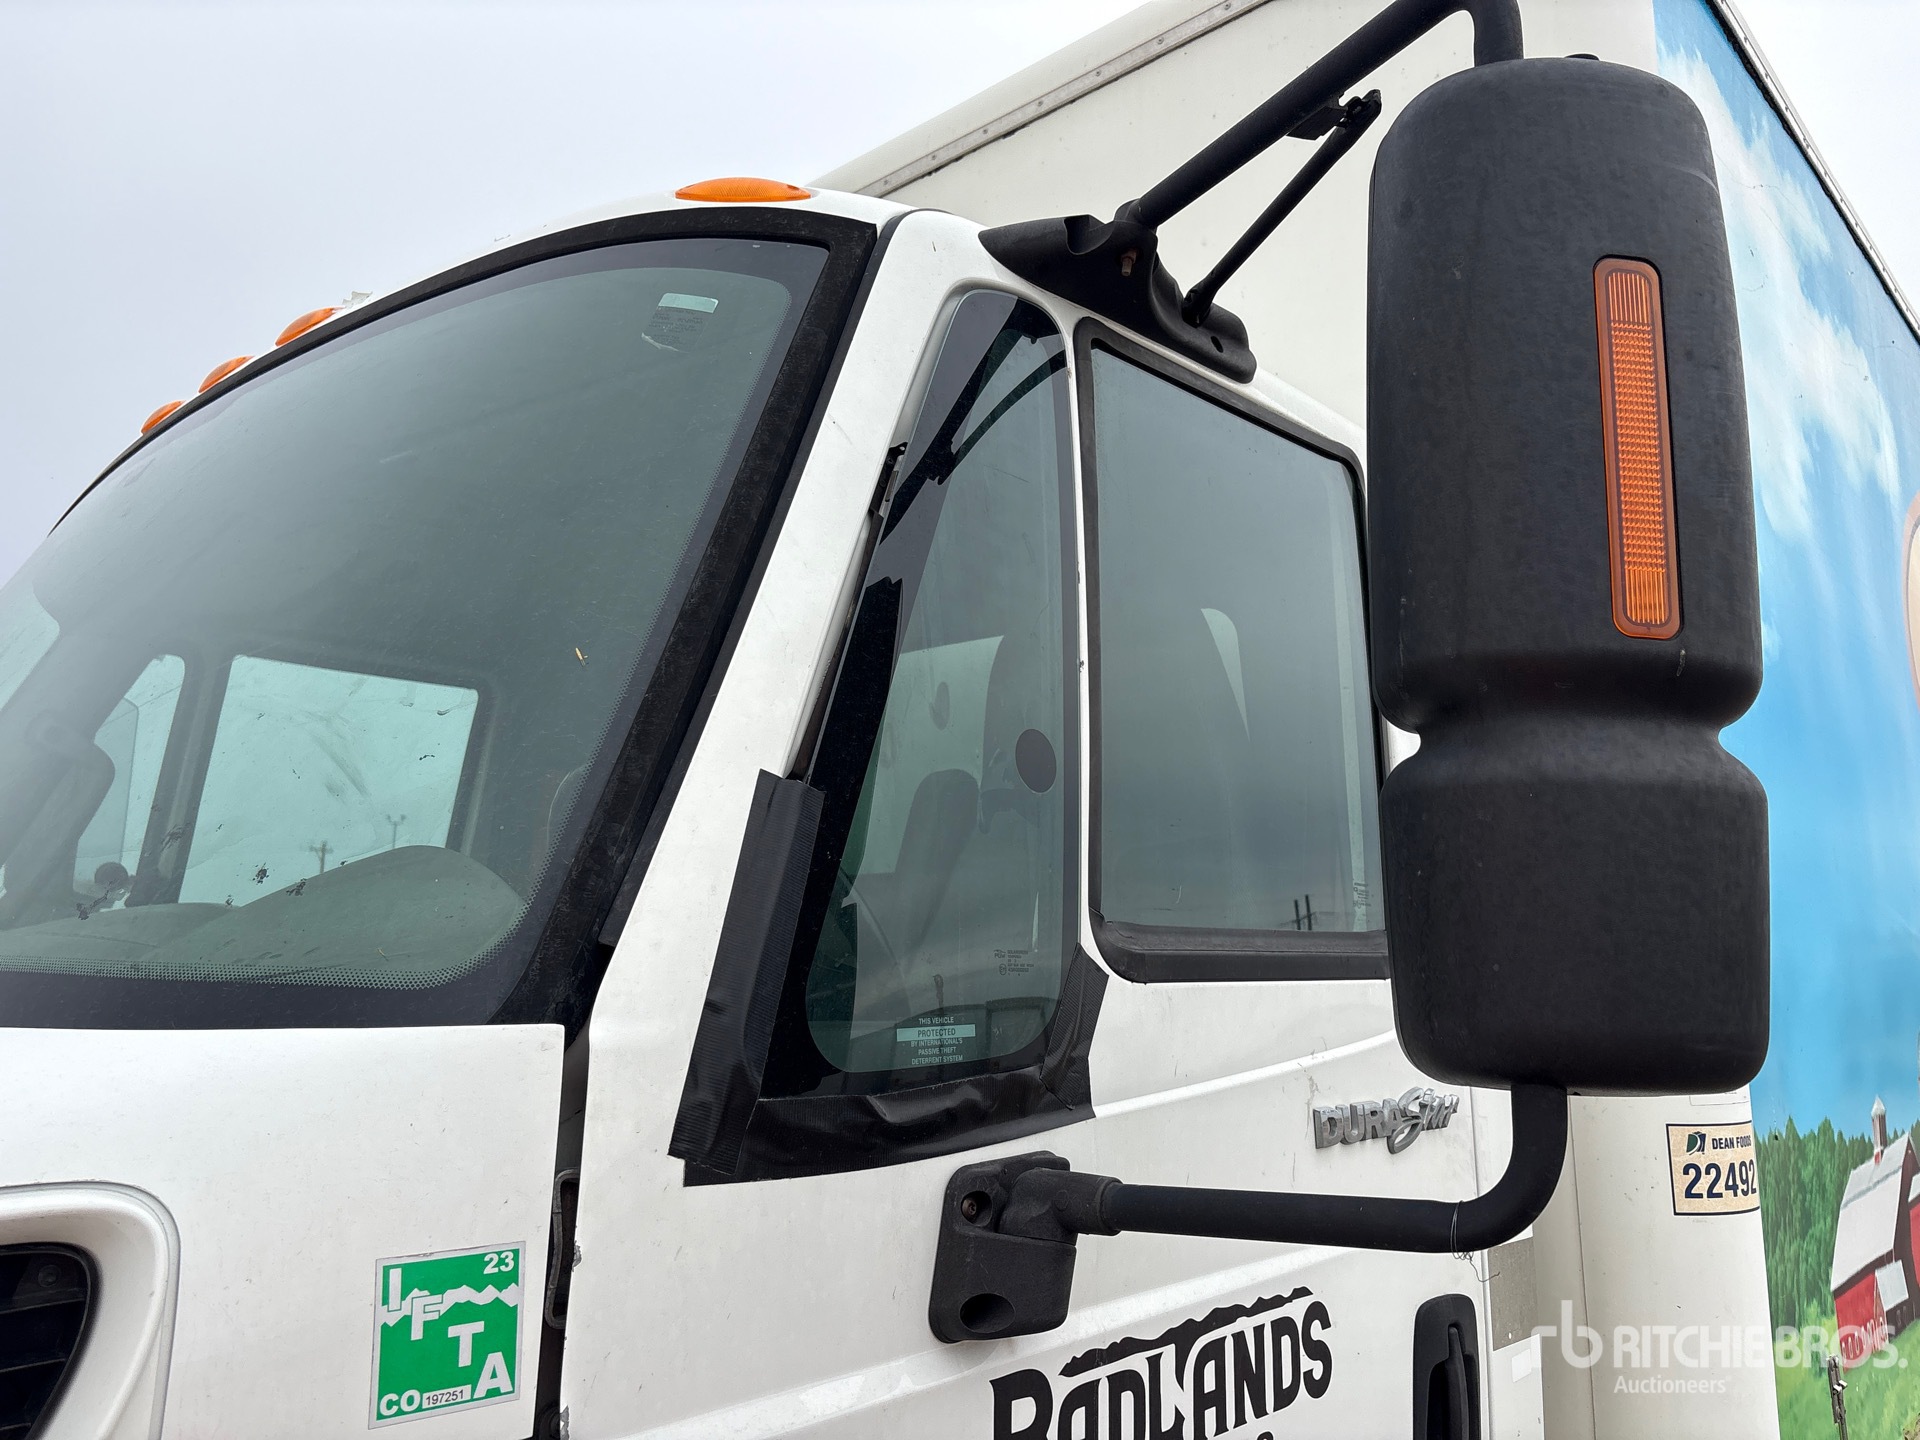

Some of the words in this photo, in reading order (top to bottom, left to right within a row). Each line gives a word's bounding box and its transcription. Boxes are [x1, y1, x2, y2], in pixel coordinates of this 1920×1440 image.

[932, 1016, 955, 1024] VEHICLE
[917, 1027, 957, 1038] PROTECTED
[910, 1040, 918, 1048] BY
[918, 1047, 940, 1055] PASSIVE
[941, 1046, 957, 1054] THEFT
[911, 1056, 942, 1065] DETERRENT
[943, 1054, 963, 1063] SYSTEM
[1711, 1136, 1736, 1150] DEAN
[1736, 1134, 1752, 1148] FOODS
[1682, 1159, 1757, 1199] 22492
[483, 1251, 515, 1275] 23
[379, 1389, 421, 1416] CO
[425, 1389, 464, 1406] 197251
